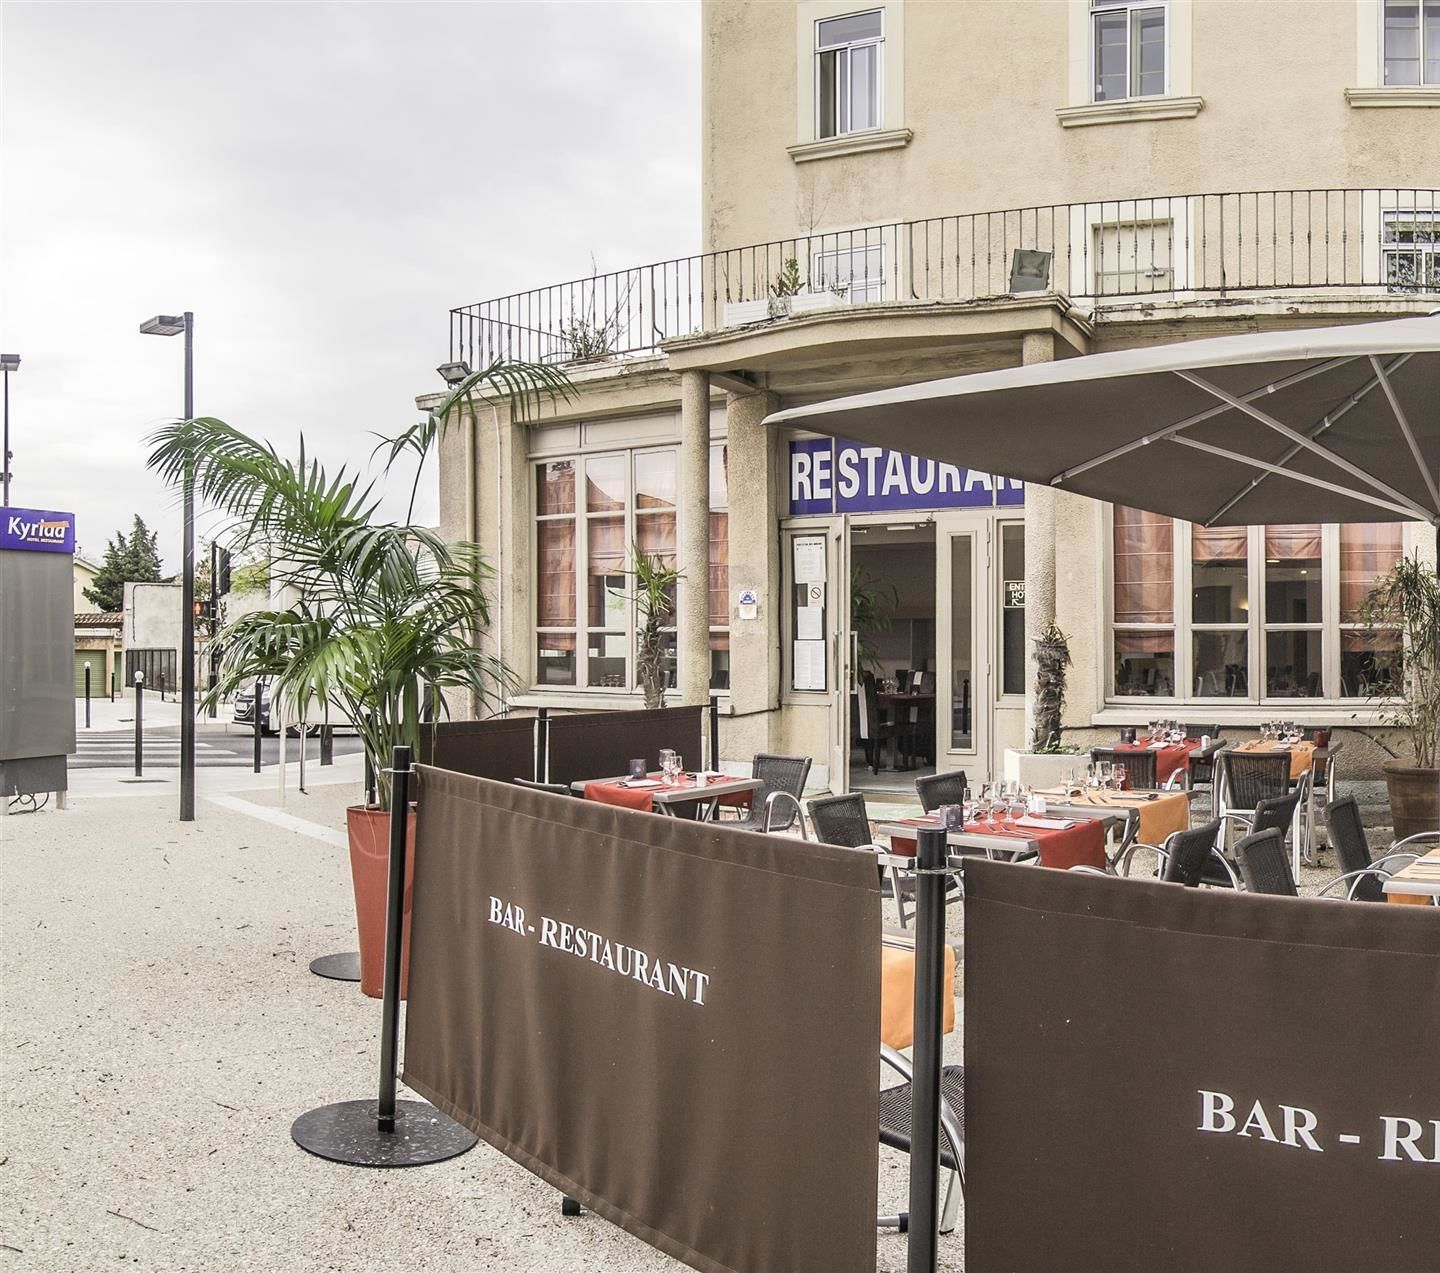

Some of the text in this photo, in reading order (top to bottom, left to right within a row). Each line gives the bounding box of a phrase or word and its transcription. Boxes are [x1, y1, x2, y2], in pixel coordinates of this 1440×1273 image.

[8, 516, 66, 540] Kyriad
[1009, 583, 1025, 591] ENT
[1011, 591, 1025, 599] HO
[488, 895, 526, 936] BAR
[538, 916, 709, 1006] RESTAURANT
[1197, 1089, 1324, 1152] BAR
